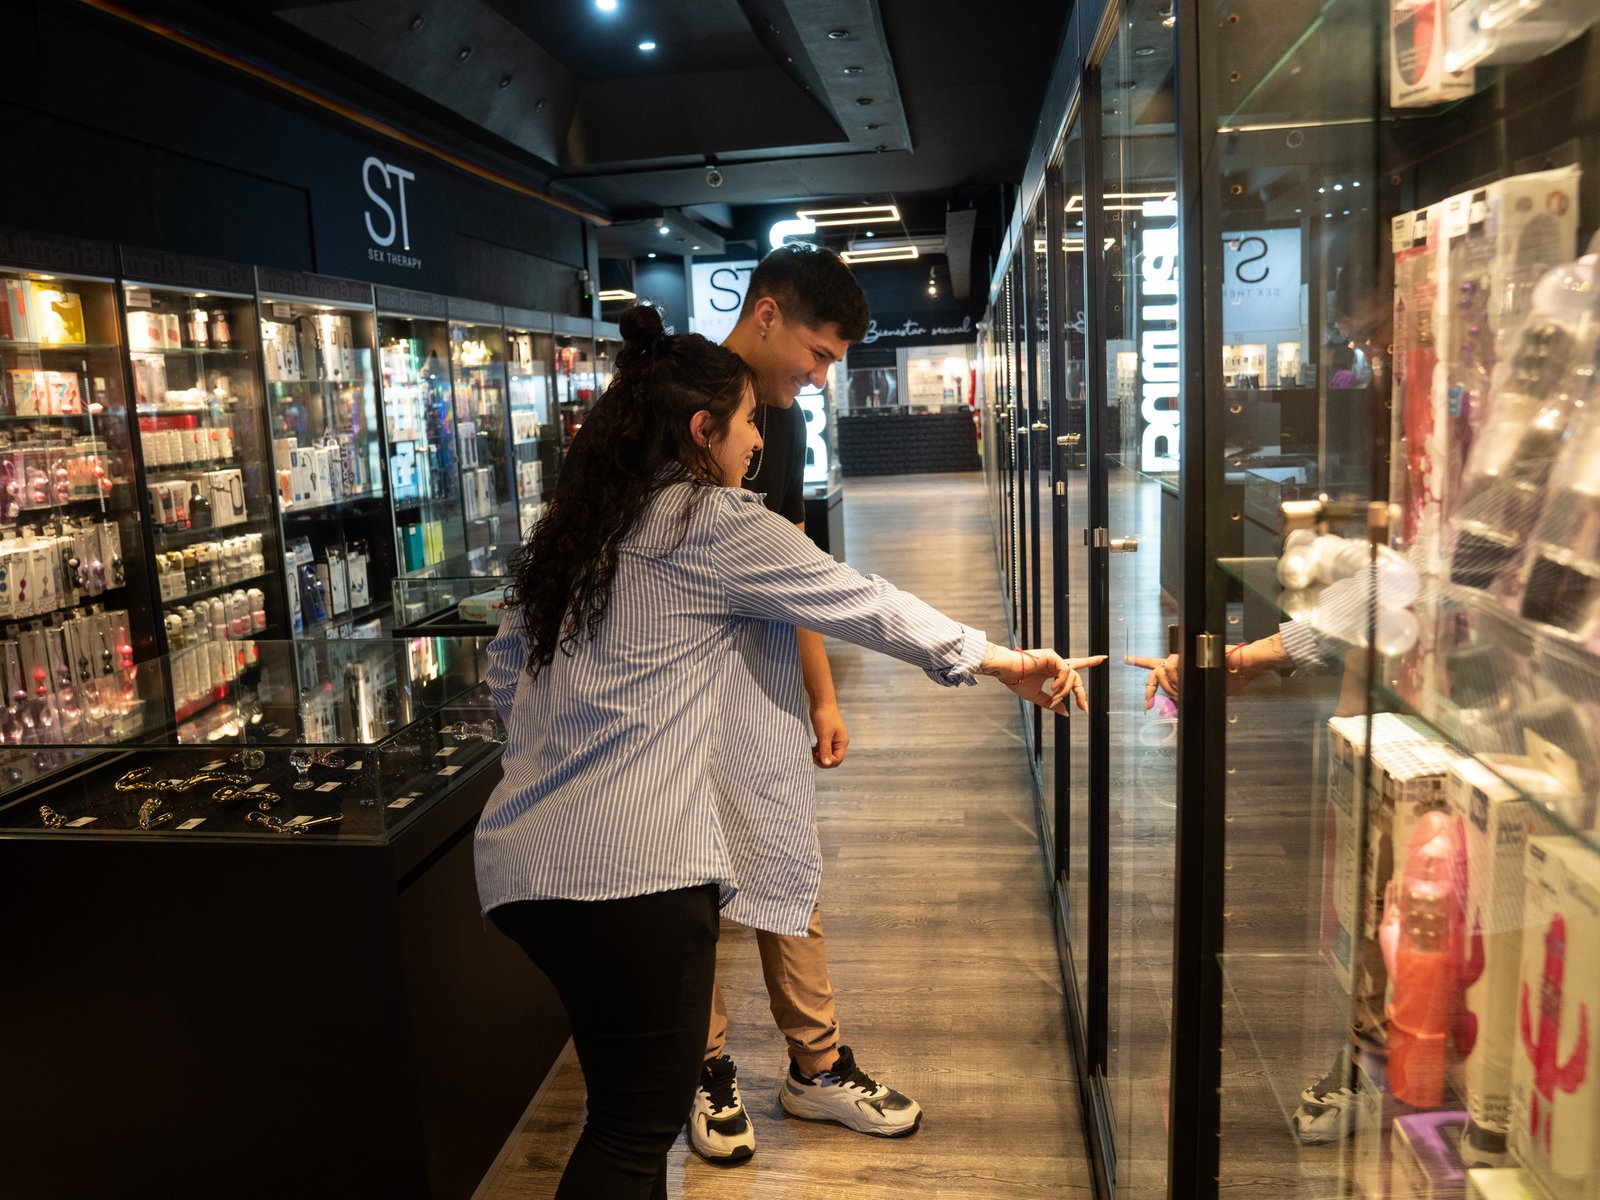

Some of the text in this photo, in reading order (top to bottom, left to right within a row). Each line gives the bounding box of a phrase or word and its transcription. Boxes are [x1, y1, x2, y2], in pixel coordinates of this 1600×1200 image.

[362, 156, 416, 251] ST
[368, 248, 422, 270] SEX THERAPY
[862, 315, 971, 344] Bienestar sexual
